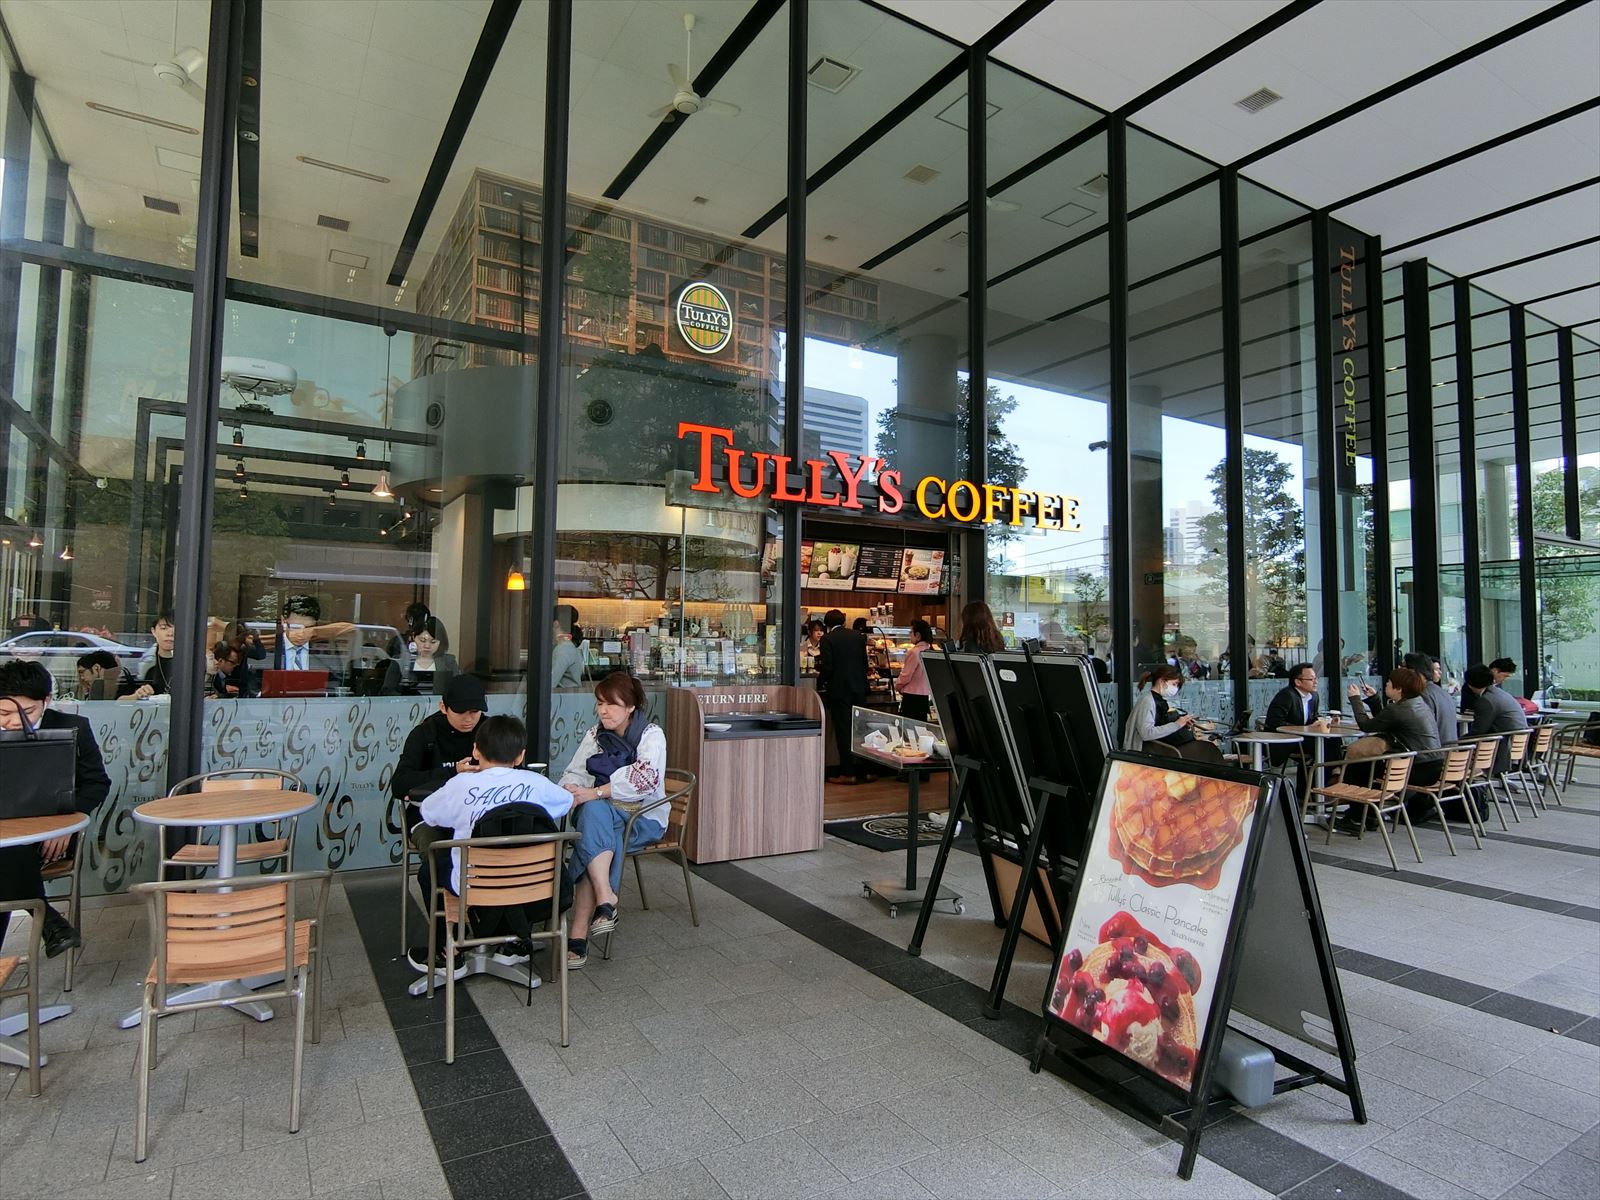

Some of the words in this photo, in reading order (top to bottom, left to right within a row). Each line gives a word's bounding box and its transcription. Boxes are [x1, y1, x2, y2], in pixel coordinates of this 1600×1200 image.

[682, 304, 728, 327] TULLY'S
[1340, 246, 1356, 350] TULLY'S
[690, 321, 720, 332] COFFEE
[1342, 358, 1357, 467] COFFEE
[677, 421, 904, 514] TULLY'S
[915, 475, 1083, 533] COFFEE
[698, 694, 736, 704] ETURN
[738, 693, 768, 704] HERE
[464, 782, 535, 806] SAIGON
[1106, 883, 1127, 907] Tully's
[1129, 892, 1161, 919] Classic
[1163, 905, 1209, 937] Pancake
